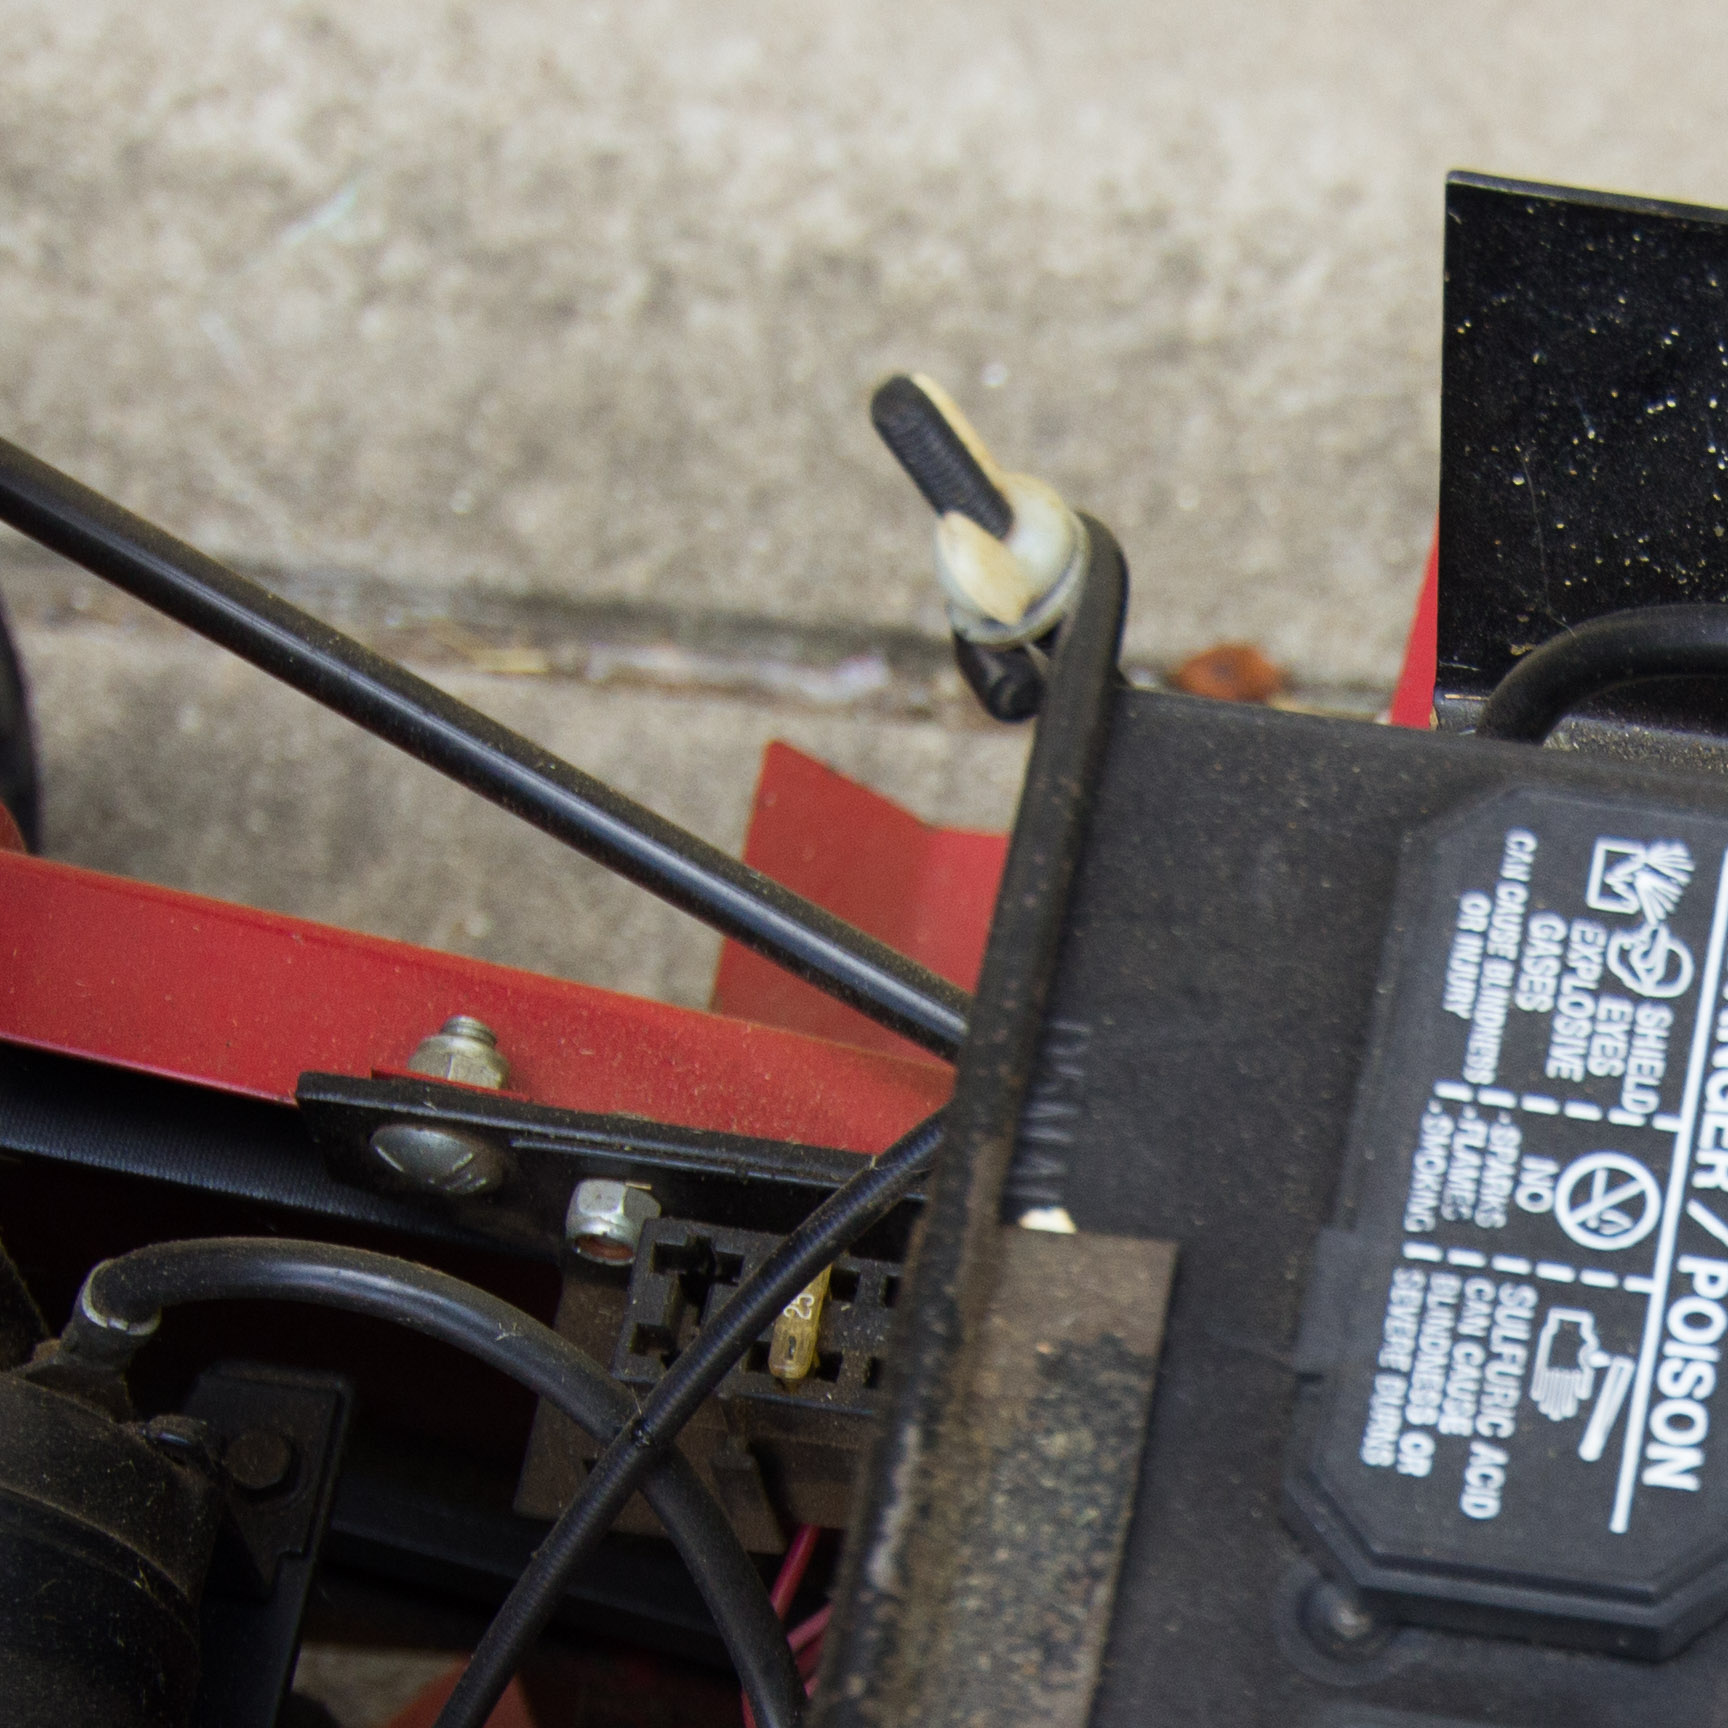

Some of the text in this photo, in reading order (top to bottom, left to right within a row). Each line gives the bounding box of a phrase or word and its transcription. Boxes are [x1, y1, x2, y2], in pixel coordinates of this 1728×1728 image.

[1444, 892, 1492, 1019] OR INJURY
[1463, 831, 1537, 1084] CAN CAUSE BLINDNESS
[1514, 914, 1567, 1012] GASES
[1546, 922, 1607, 1080] EXPLOSIVE
[1586, 996, 1634, 1076] EYES
[1619, 1003, 1673, 1115] SHIELD
[1513, 1155, 1559, 1213] NO
[1361, 1268, 1426, 1466] SEVERE BURNS
[1396, 1273, 1460, 1477] BLINDNESS OR
[1437, 1277, 1496, 1436] CAN CAUSE
[1460, 1284, 1536, 1519] SULFURIC ACID
